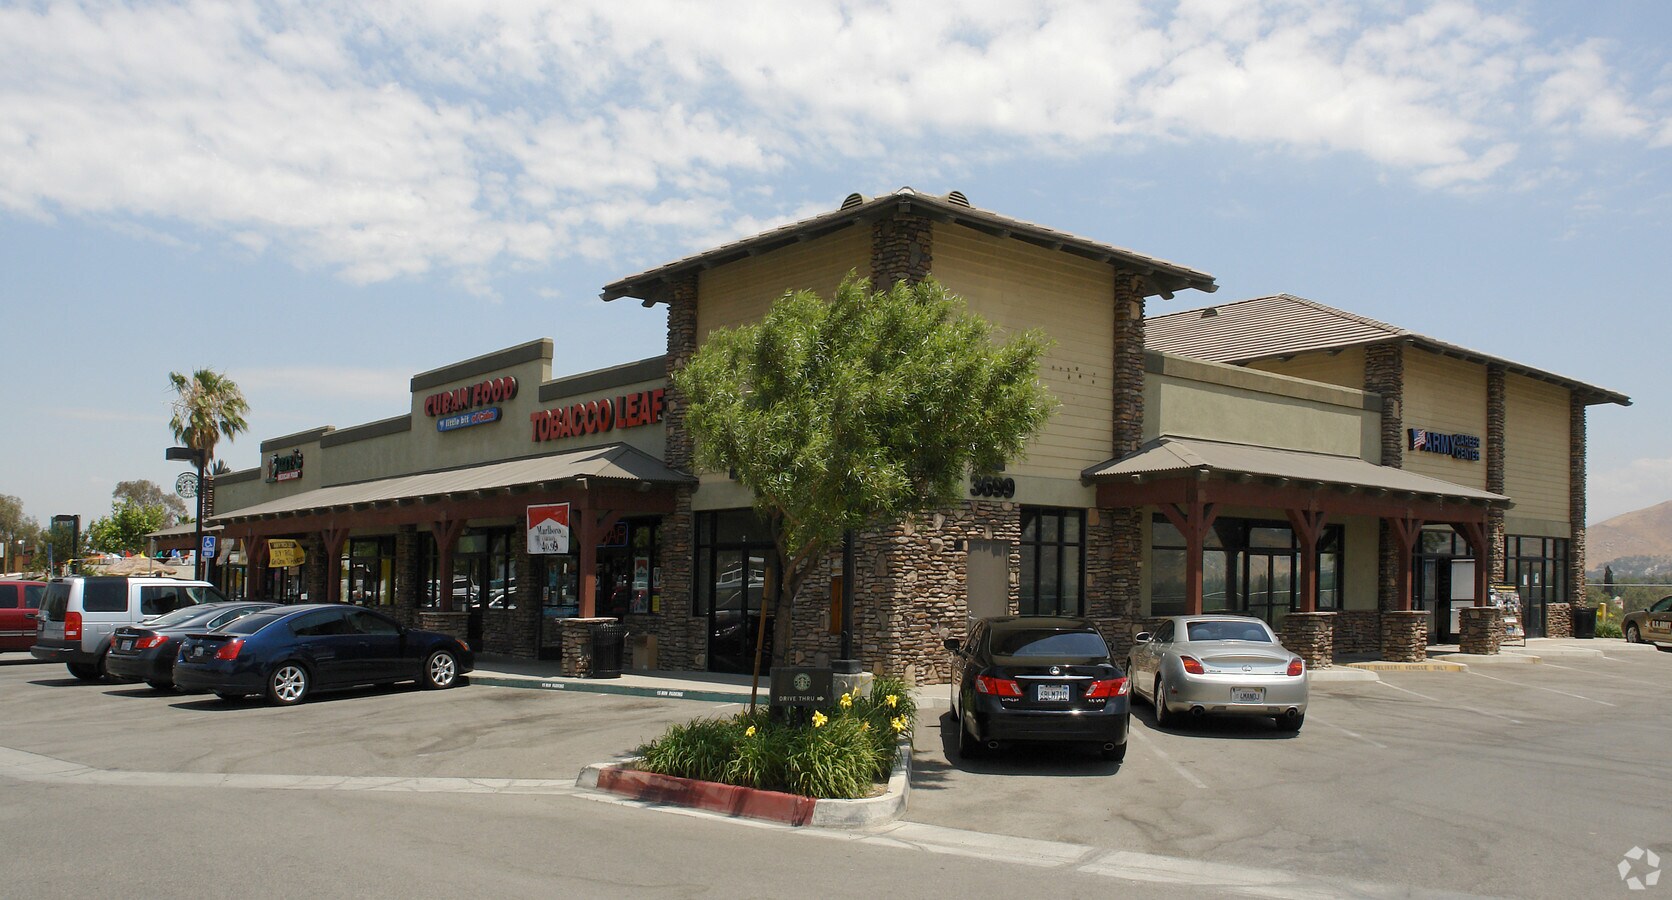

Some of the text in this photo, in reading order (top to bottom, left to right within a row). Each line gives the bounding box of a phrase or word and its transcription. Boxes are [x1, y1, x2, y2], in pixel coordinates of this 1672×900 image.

[424, 376, 518, 417] CUBAN FOOD
[530, 388, 664, 442] TOBACCO LEAF
[1425, 432, 1480, 456] ARMY CAREER
[1456, 447, 1480, 461] CENTER
[970, 474, 1015, 498] 3699
[537, 525, 562, 535] Marlboro
